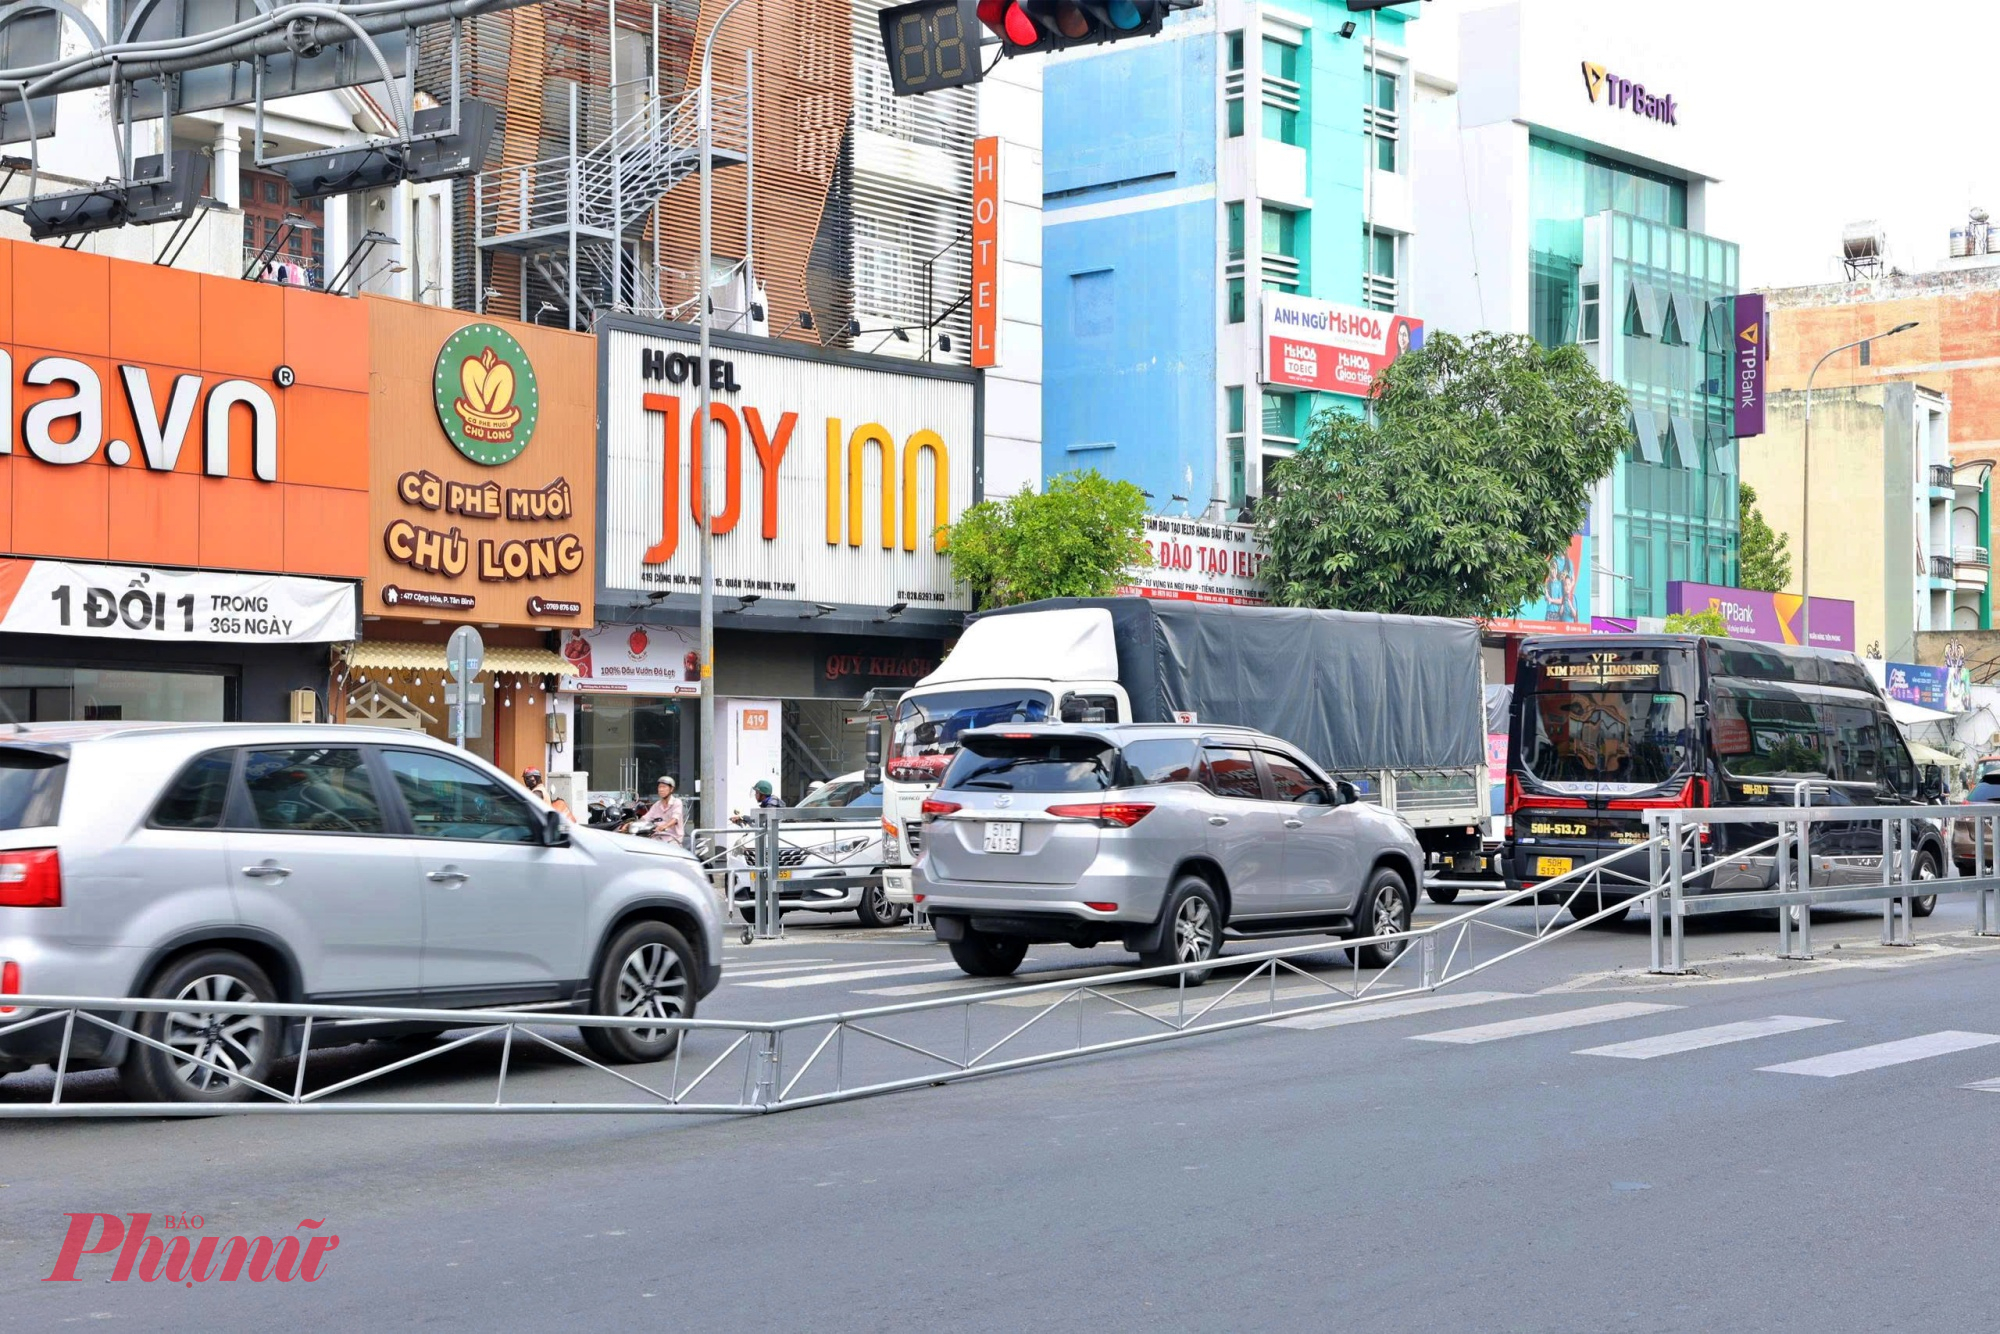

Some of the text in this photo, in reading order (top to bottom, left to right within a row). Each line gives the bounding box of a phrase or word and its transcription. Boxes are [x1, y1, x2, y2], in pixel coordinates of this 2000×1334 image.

[1605, 73, 1678, 127] TPBank
[977, 155, 994, 350] HOTEL
[1274, 307, 1299, 325] ANH
[642, 348, 741, 393] HOTEL
[1288, 362, 1313, 375] TOEIC
[1741, 346, 1757, 409] TPBank
[487, 430, 512, 440] LONG
[642, 392, 799, 565] JOY
[450, 484, 501, 514] PHÊ
[1234, 531, 1246, 543] NAM
[388, 522, 583, 578] CHÚ LONG
[1198, 546, 1228, 580] TẠO
[51, 573, 195, 633] 1 ĐỔI 1
[210, 594, 269, 613] TRONG
[1720, 601, 1754, 623] TPBank
[209, 616, 293, 636] 365 NGÀY
[1591, 653, 1618, 664] VIP
[601, 666, 620, 677] 100%
[1546, 663, 1660, 677] KIM PHÁT LIMOUSINE
[746, 714, 765, 726] 419
[1531, 823, 1587, 836] 50H-513.73
[1610, 831, 1624, 839] Kim
[1547, 858, 1562, 867] 50H
